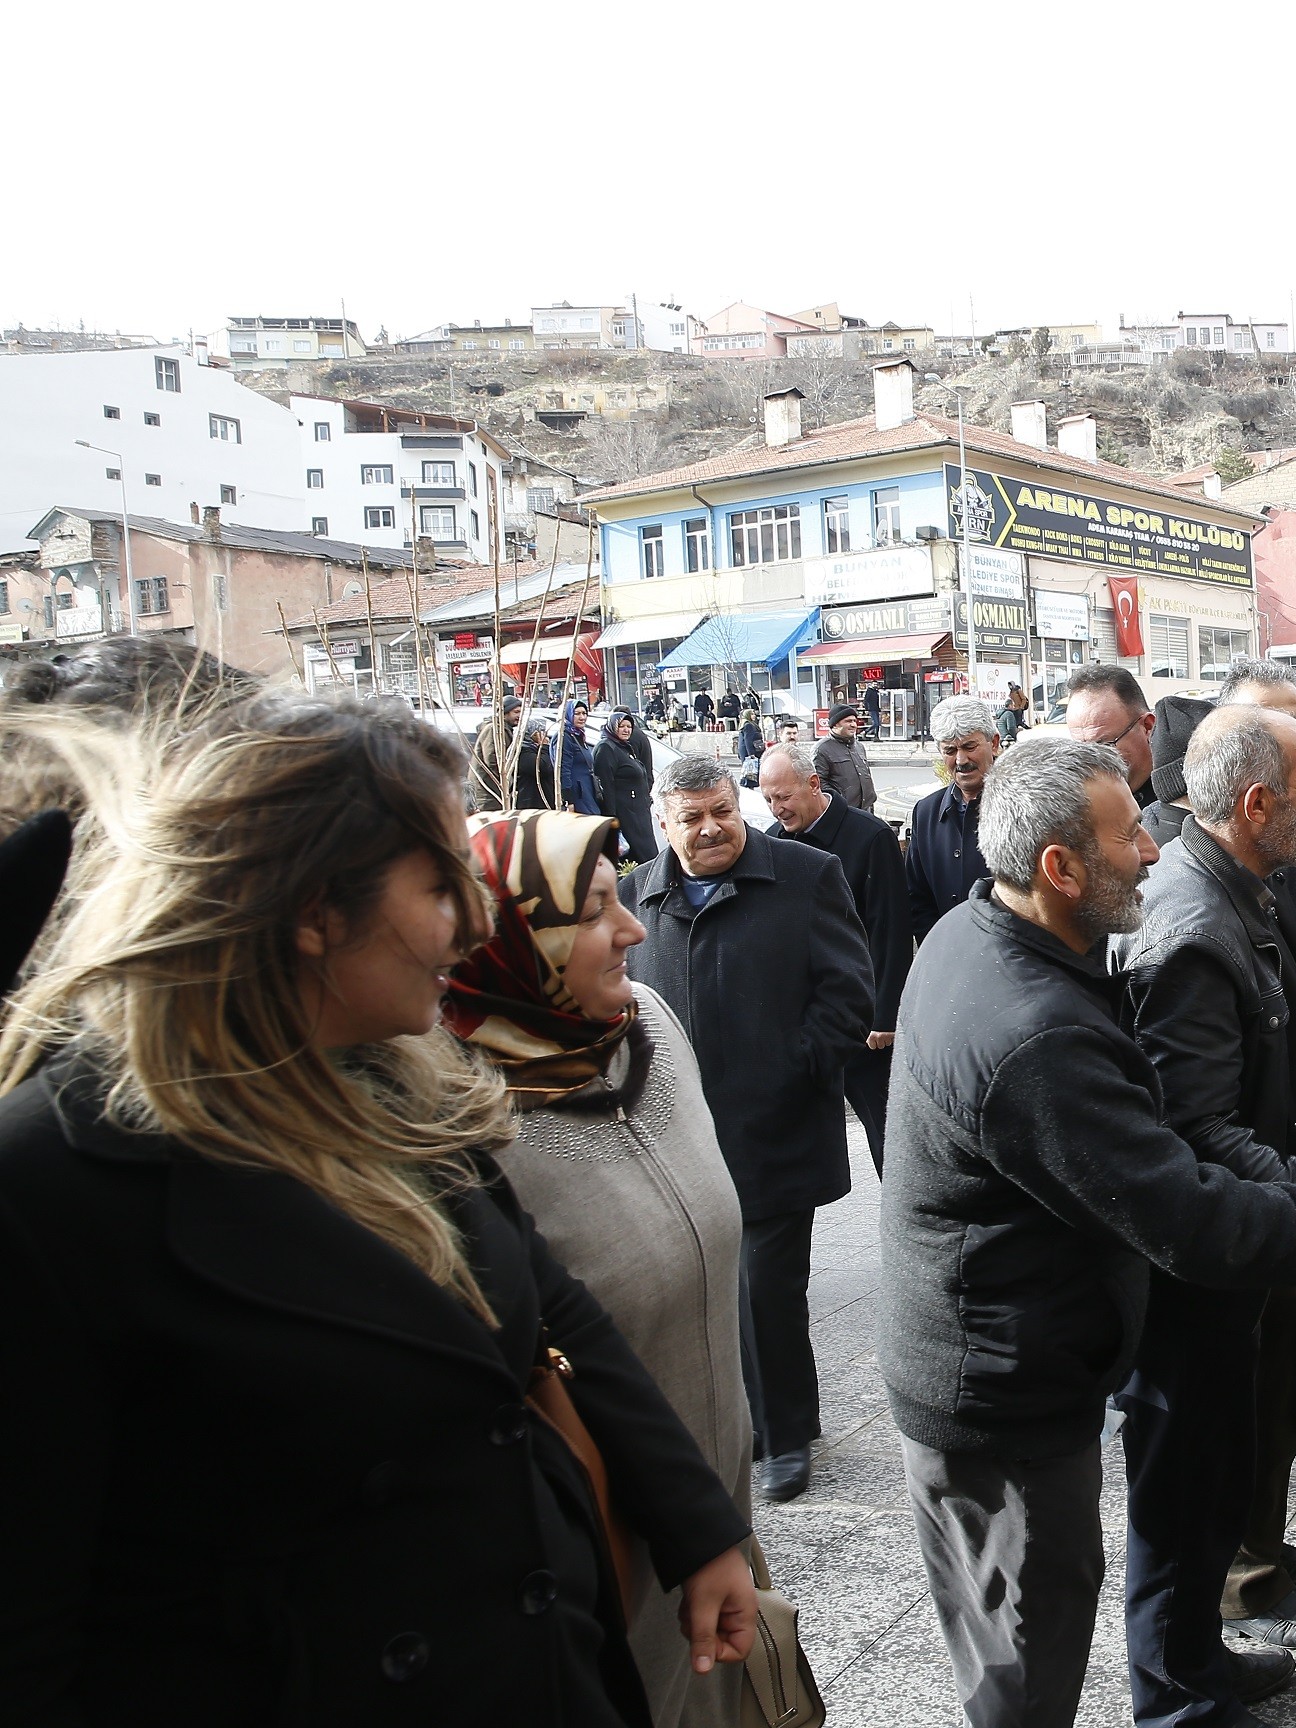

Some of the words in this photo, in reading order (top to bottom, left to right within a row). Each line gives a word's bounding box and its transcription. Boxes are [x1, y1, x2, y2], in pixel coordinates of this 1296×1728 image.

[1016, 486, 1102, 522] ARENA
[1106, 505, 1165, 535] SPOR
[1168, 518, 1245, 551] KULÜBÜ
[1012, 523, 1041, 537] TAEKWONDO
[1134, 531, 1151, 543] TEAM
[1191, 542, 1200, 552] 20
[999, 573, 1021, 586] SPOR
[846, 607, 906, 635] OSMANLI
[973, 602, 1025, 631] OSMANLI
[331, 643, 357, 654] Hürriyet
